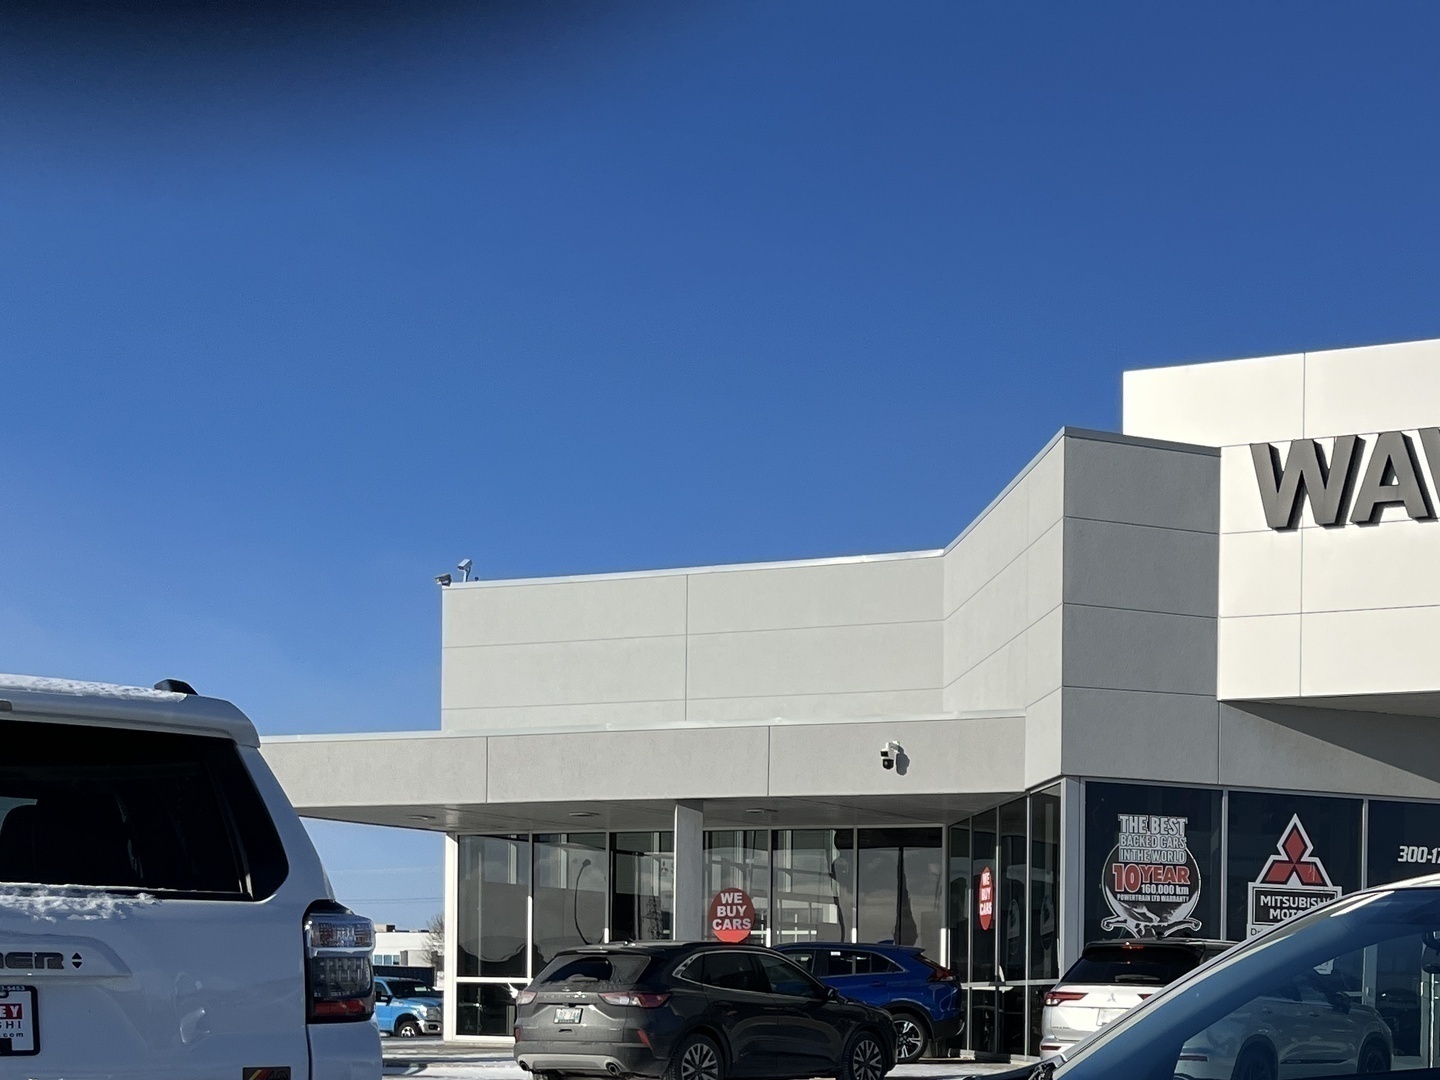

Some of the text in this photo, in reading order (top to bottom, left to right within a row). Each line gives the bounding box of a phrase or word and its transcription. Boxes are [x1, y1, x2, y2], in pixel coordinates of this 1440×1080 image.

[1119, 815, 1187, 836] THE BEST
[1120, 834, 1187, 849] BACKED CARS
[1121, 848, 1187, 863] IN THE WORLD
[1112, 863, 1191, 893] 10 YEAR
[1141, 884, 1190, 896] 160,000 km
[720, 892, 743, 904] WE
[1260, 895, 1331, 909] MITSUBIS
[716, 905, 748, 918] BUY
[1269, 908, 1306, 920] MOT
[712, 918, 752, 931] CARS
